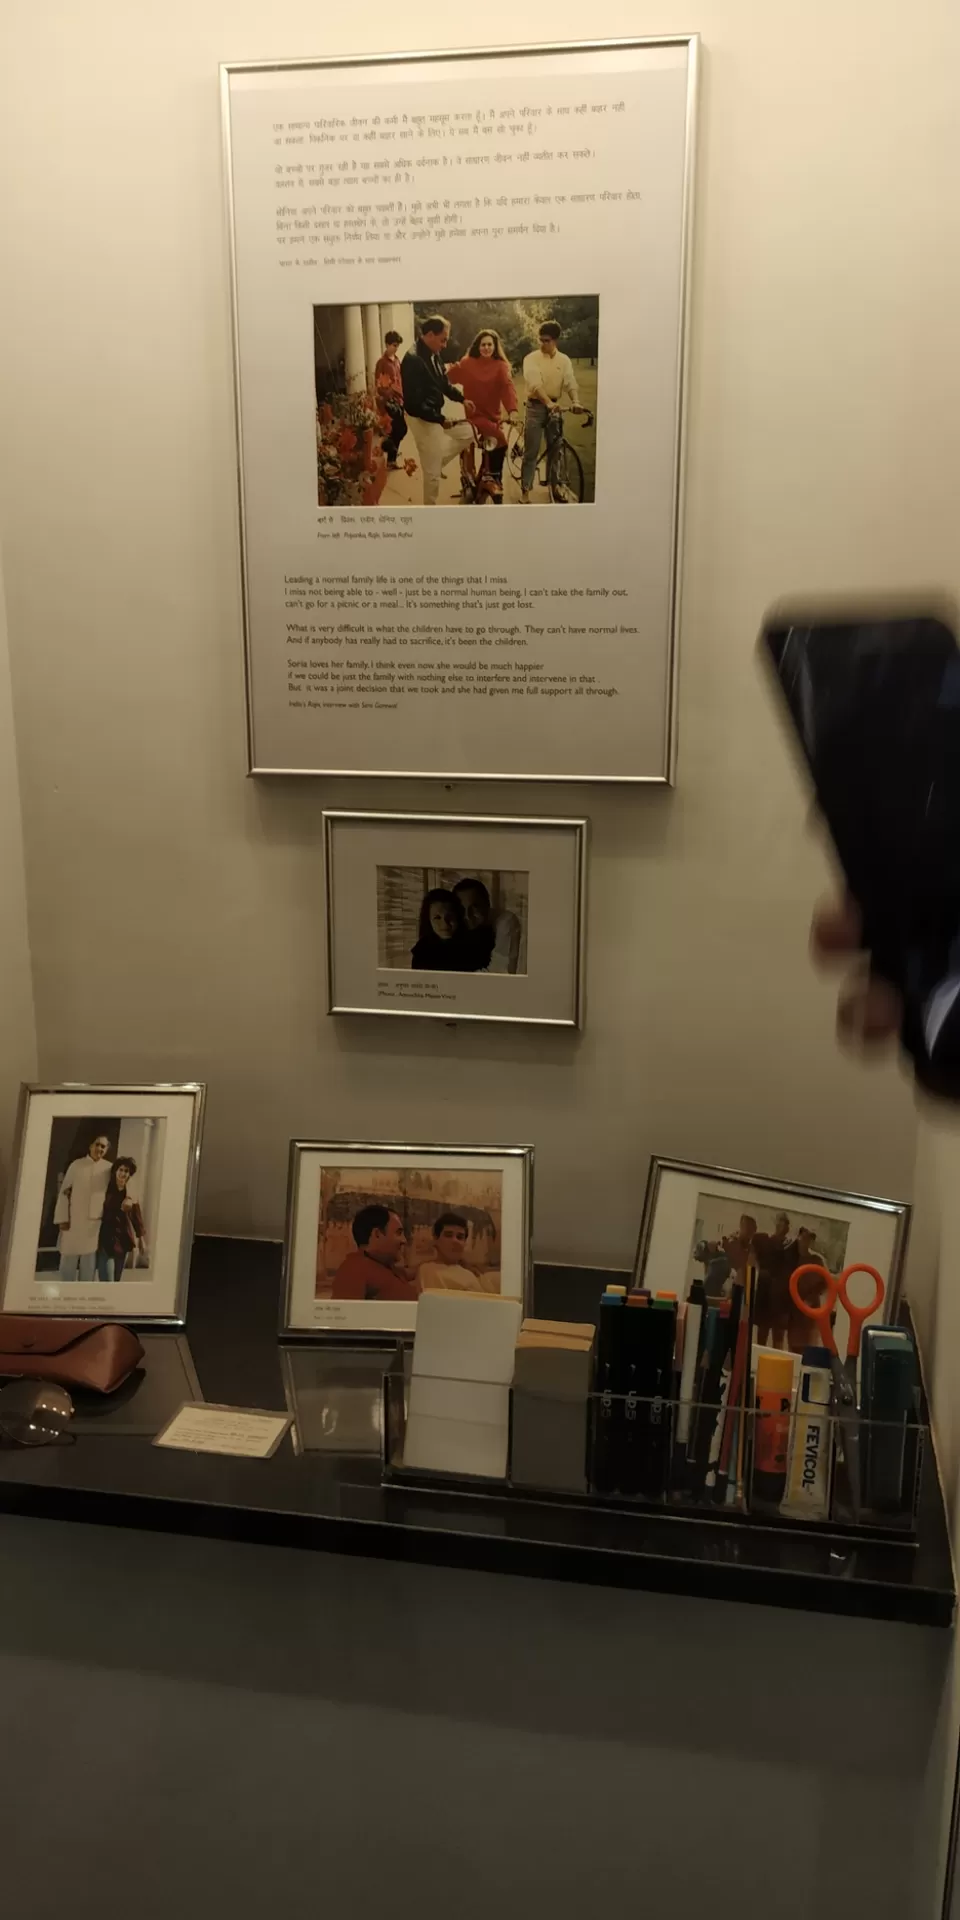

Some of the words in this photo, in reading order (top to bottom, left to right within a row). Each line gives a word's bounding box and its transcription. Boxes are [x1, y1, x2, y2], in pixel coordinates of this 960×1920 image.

[284, 575, 313, 586] Leading
[322, 575, 349, 584] normal
[351, 575, 374, 586] family
[376, 575, 388, 584] life
[426, 575, 439, 584] the
[441, 575, 464, 586] things
[466, 575, 482, 584] that
[308, 587, 322, 596] not
[323, 587, 345, 598] being
[346, 587, 362, 596] able
[381, 588, 397, 596] well
[405, 588, 420, 598] just
[440, 588, 469, 596] normal
[470, 588, 497, 596] human
[551, 588, 568, 596] take
[570, 588, 584, 596] the
[585, 588, 610, 599] family
[317, 600, 329, 608] for
[337, 600, 359, 611] picnic
[419, 600, 460, 611] something
[485, 600, 500, 611] just
[502, 600, 515, 611] got
[286, 624, 308, 632] What
[318, 626, 335, 635] very
[337, 624, 365, 633] difficult
[375, 624, 394, 633] what
[396, 624, 410, 633] the
[411, 624, 443, 633] children
[445, 624, 463, 633] have
[524, 625, 545, 635] They
[568, 625, 586, 634] have
[588, 625, 618, 634] normal
[286, 636, 303, 644] And
[311, 636, 343, 647] anybody
[345, 636, 358, 645] has
[360, 636, 381, 647] really
[382, 636, 397, 645] had
[458, 637, 477, 645] been
[479, 637, 492, 645] the
[309, 660, 329, 669] loves
[331, 660, 344, 669] her
[376, 660, 395, 669] think
[436, 661, 450, 669] she
[453, 661, 476, 669] would
[490, 661, 513, 670] much
[514, 661, 544, 672] happier
[308, 672, 329, 680] could
[342, 672, 356, 683] just
[358, 672, 371, 681] the
[373, 672, 396, 683] family
[397, 672, 414, 681] with
[416, 673, 446, 683] nothing
[448, 673, 463, 681] else
[512, 673, 527, 682] and
[336, 684, 354, 695] joint
[356, 684, 387, 693] decision
[389, 684, 405, 693] that
[420, 685, 439, 693] took
[441, 685, 456, 693] and
[457, 685, 470, 694] she
[473, 685, 487, 694] had
[526, 686, 539, 694] full
[540, 686, 572, 697] support
[574, 686, 584, 695] all
[802, 1425, 820, 1488] FEVICOL
